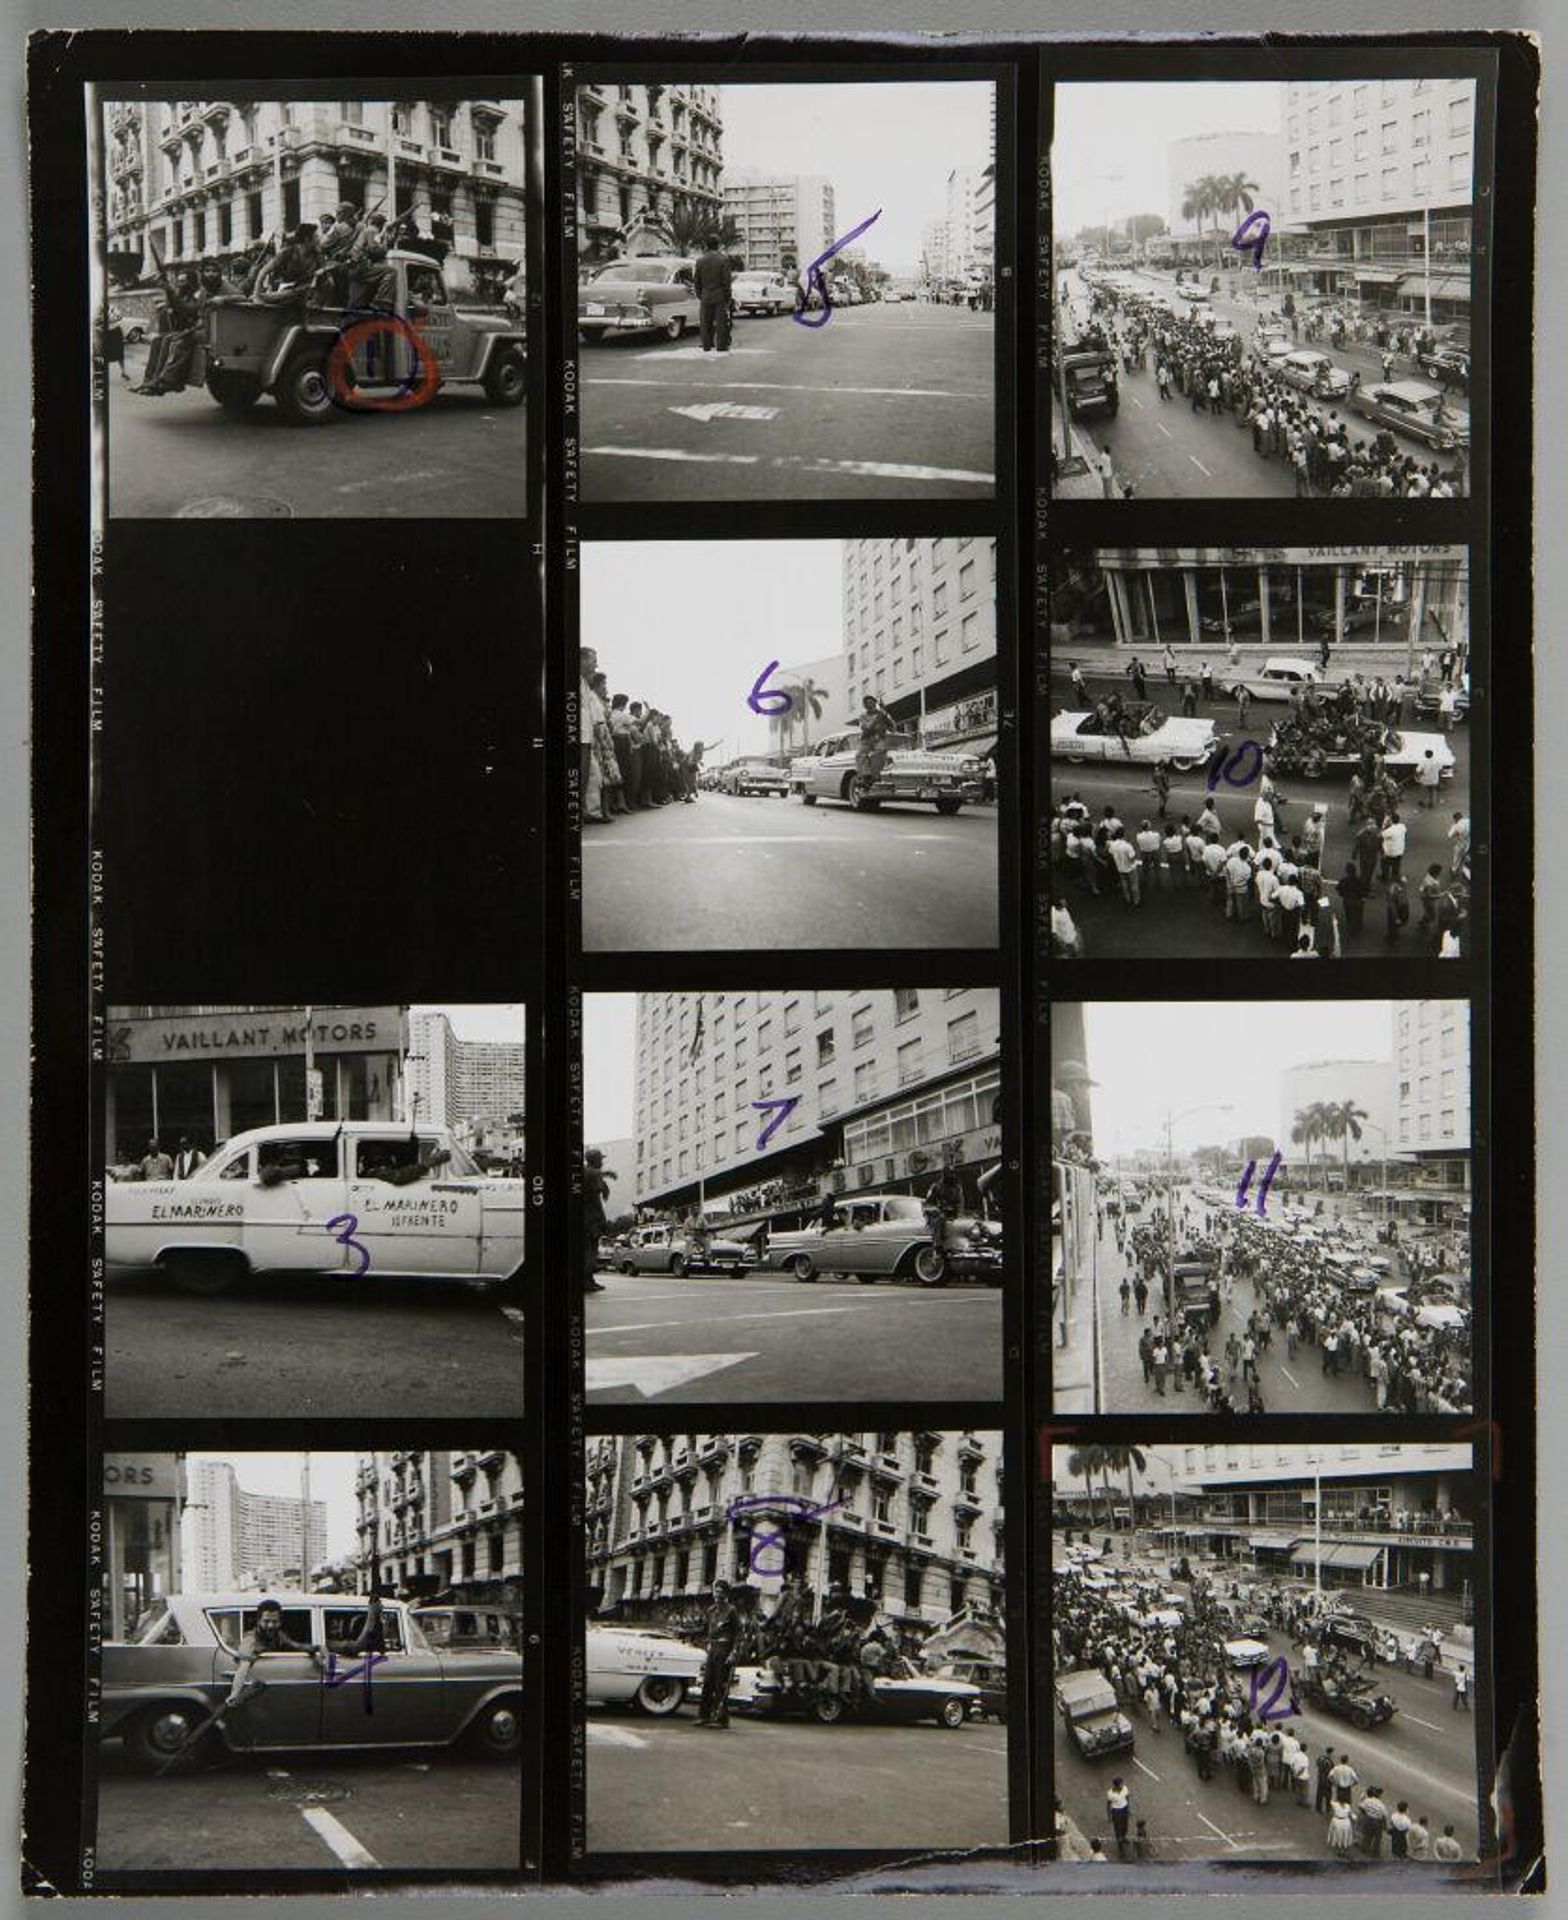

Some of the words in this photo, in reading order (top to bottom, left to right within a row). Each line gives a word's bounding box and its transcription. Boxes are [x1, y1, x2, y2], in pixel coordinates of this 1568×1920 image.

[1038, 156, 1049, 211] KODAK
[563, 192, 574, 239] FILM
[1232, 209, 1271, 271] 9
[793, 208, 882, 330] 5
[1038, 324, 1049, 370] FILM
[93, 356, 104, 401] FILM
[1036, 485, 1047, 541] KODAK
[565, 526, 577, 570] FILM
[746, 660, 793, 717] 6
[1036, 652, 1047, 695] FILM
[92, 687, 103, 731] FILM
[566, 691, 578, 745] KODAK
[1208, 740, 1263, 791] 10
[92, 850, 103, 905] KODAK
[568, 855, 580, 900] FILM
[92, 1016, 103, 1061] FILM
[162, 1028, 271, 1051] VAILLANT
[283, 1022, 377, 1047] MOTORS
[750, 1096, 802, 1152] 7
[570, 1150, 582, 1196] FILM
[1235, 1148, 1283, 1219] 11
[91, 1180, 103, 1235] KODAK
[326, 1213, 370, 1280] 3
[91, 1346, 103, 1391] FILM
[104, 1465, 154, 1485] ORS
[90, 1510, 101, 1565] KODAK
[88, 1678, 99, 1723] FILM
[1249, 1656, 1301, 1721] 12
